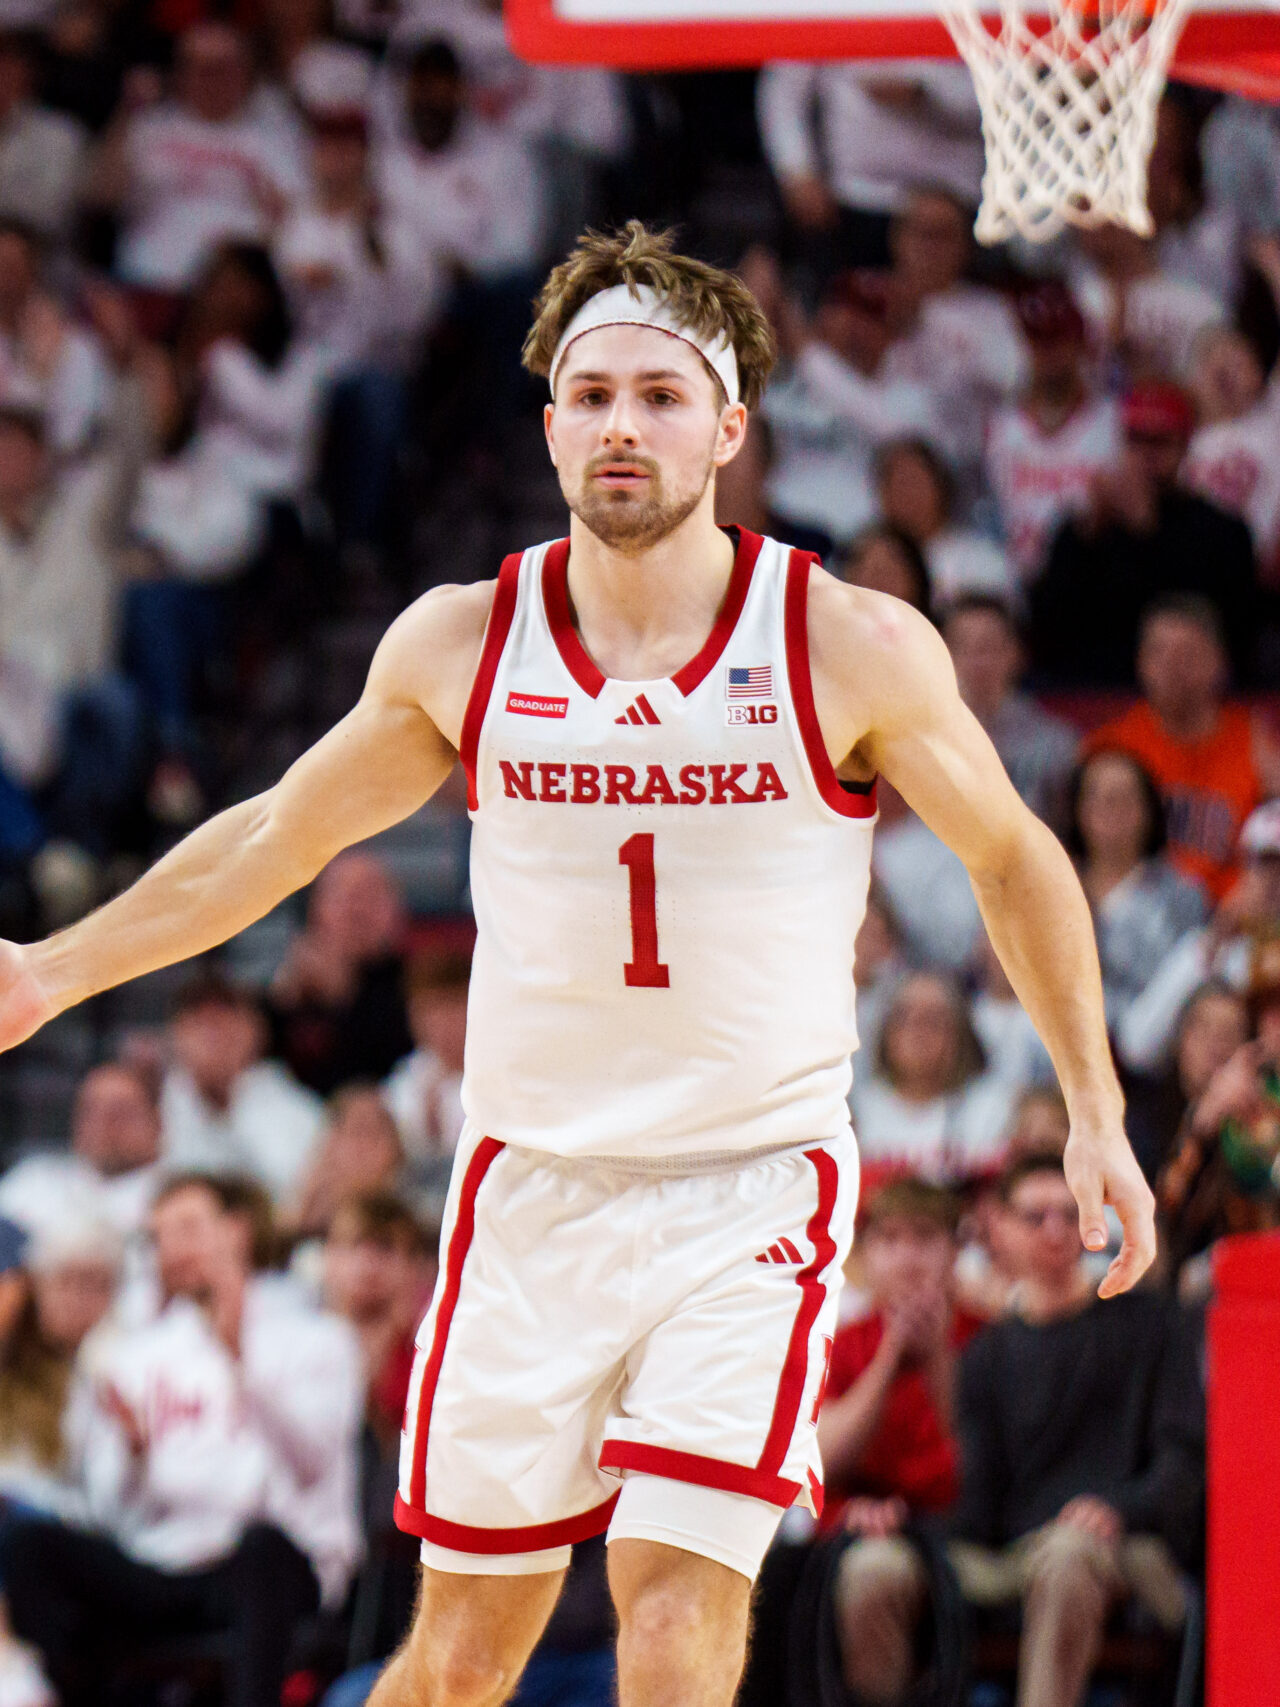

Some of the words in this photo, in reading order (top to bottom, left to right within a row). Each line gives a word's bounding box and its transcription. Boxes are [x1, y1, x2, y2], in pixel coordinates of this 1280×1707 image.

[510, 698, 566, 713] GRADUATE
[499, 761, 788, 805] NEBRASKA
[618, 832, 670, 988] 1
